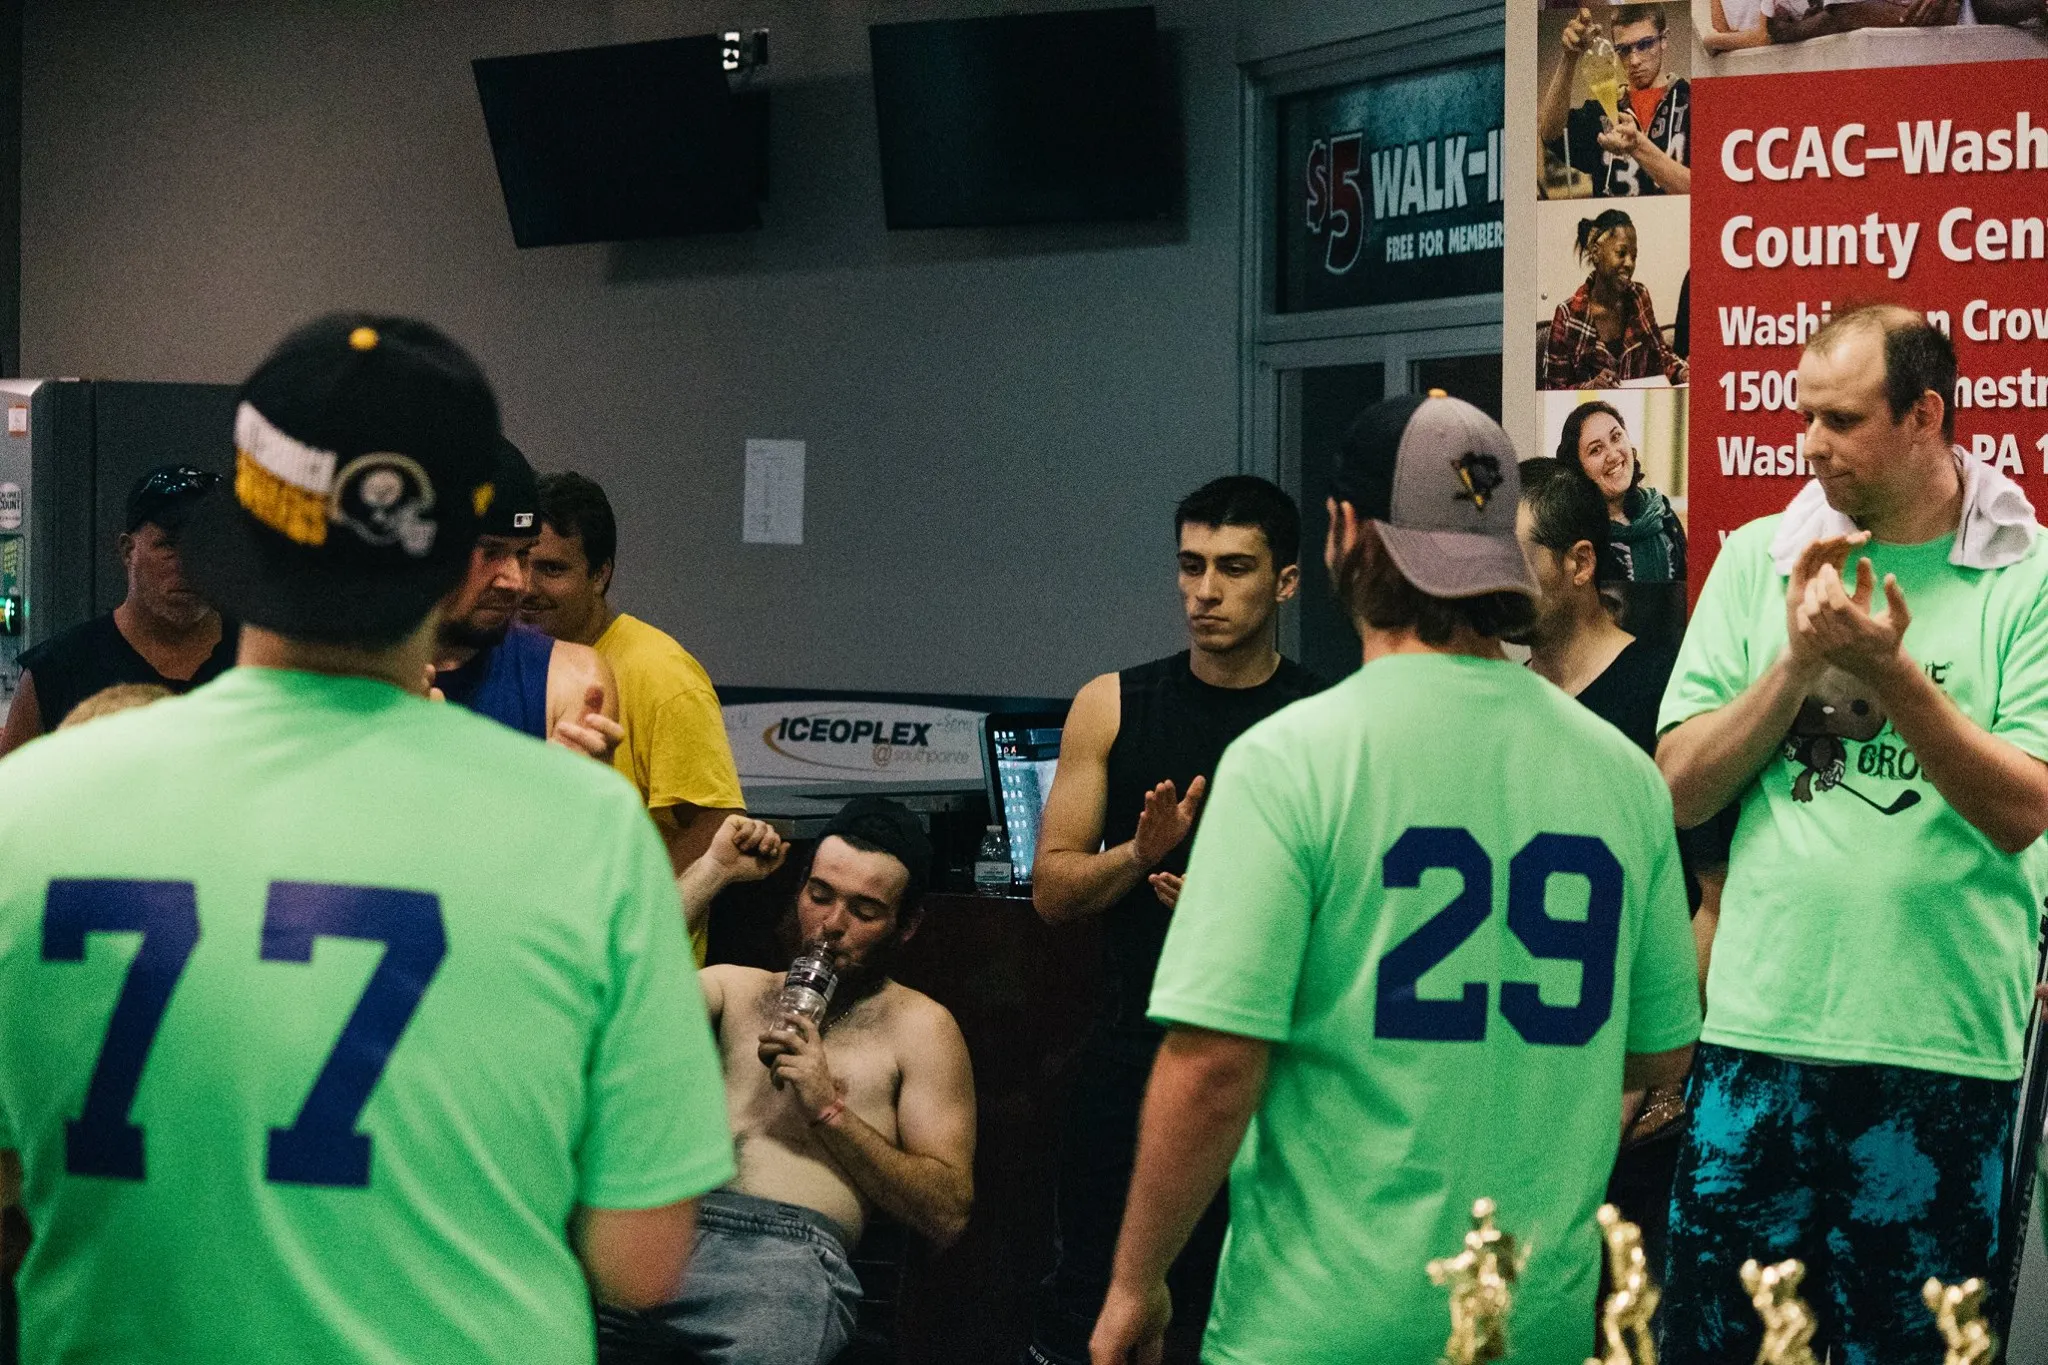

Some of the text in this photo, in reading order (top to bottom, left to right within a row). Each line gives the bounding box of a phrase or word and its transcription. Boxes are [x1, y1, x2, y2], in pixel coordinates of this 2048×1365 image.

[1306, 132, 1364, 275] $5
[1371, 129, 1504, 220] WALK-I
[1386, 231, 1414, 262] FREE
[1418, 229, 1444, 258] FOR
[1720, 206, 2048, 280] County Cen
[1972, 433, 2025, 475] PA
[777, 716, 933, 747] ICEOPLEX
[1374, 826, 1625, 1046] 29
[41, 876, 448, 1187] 77
